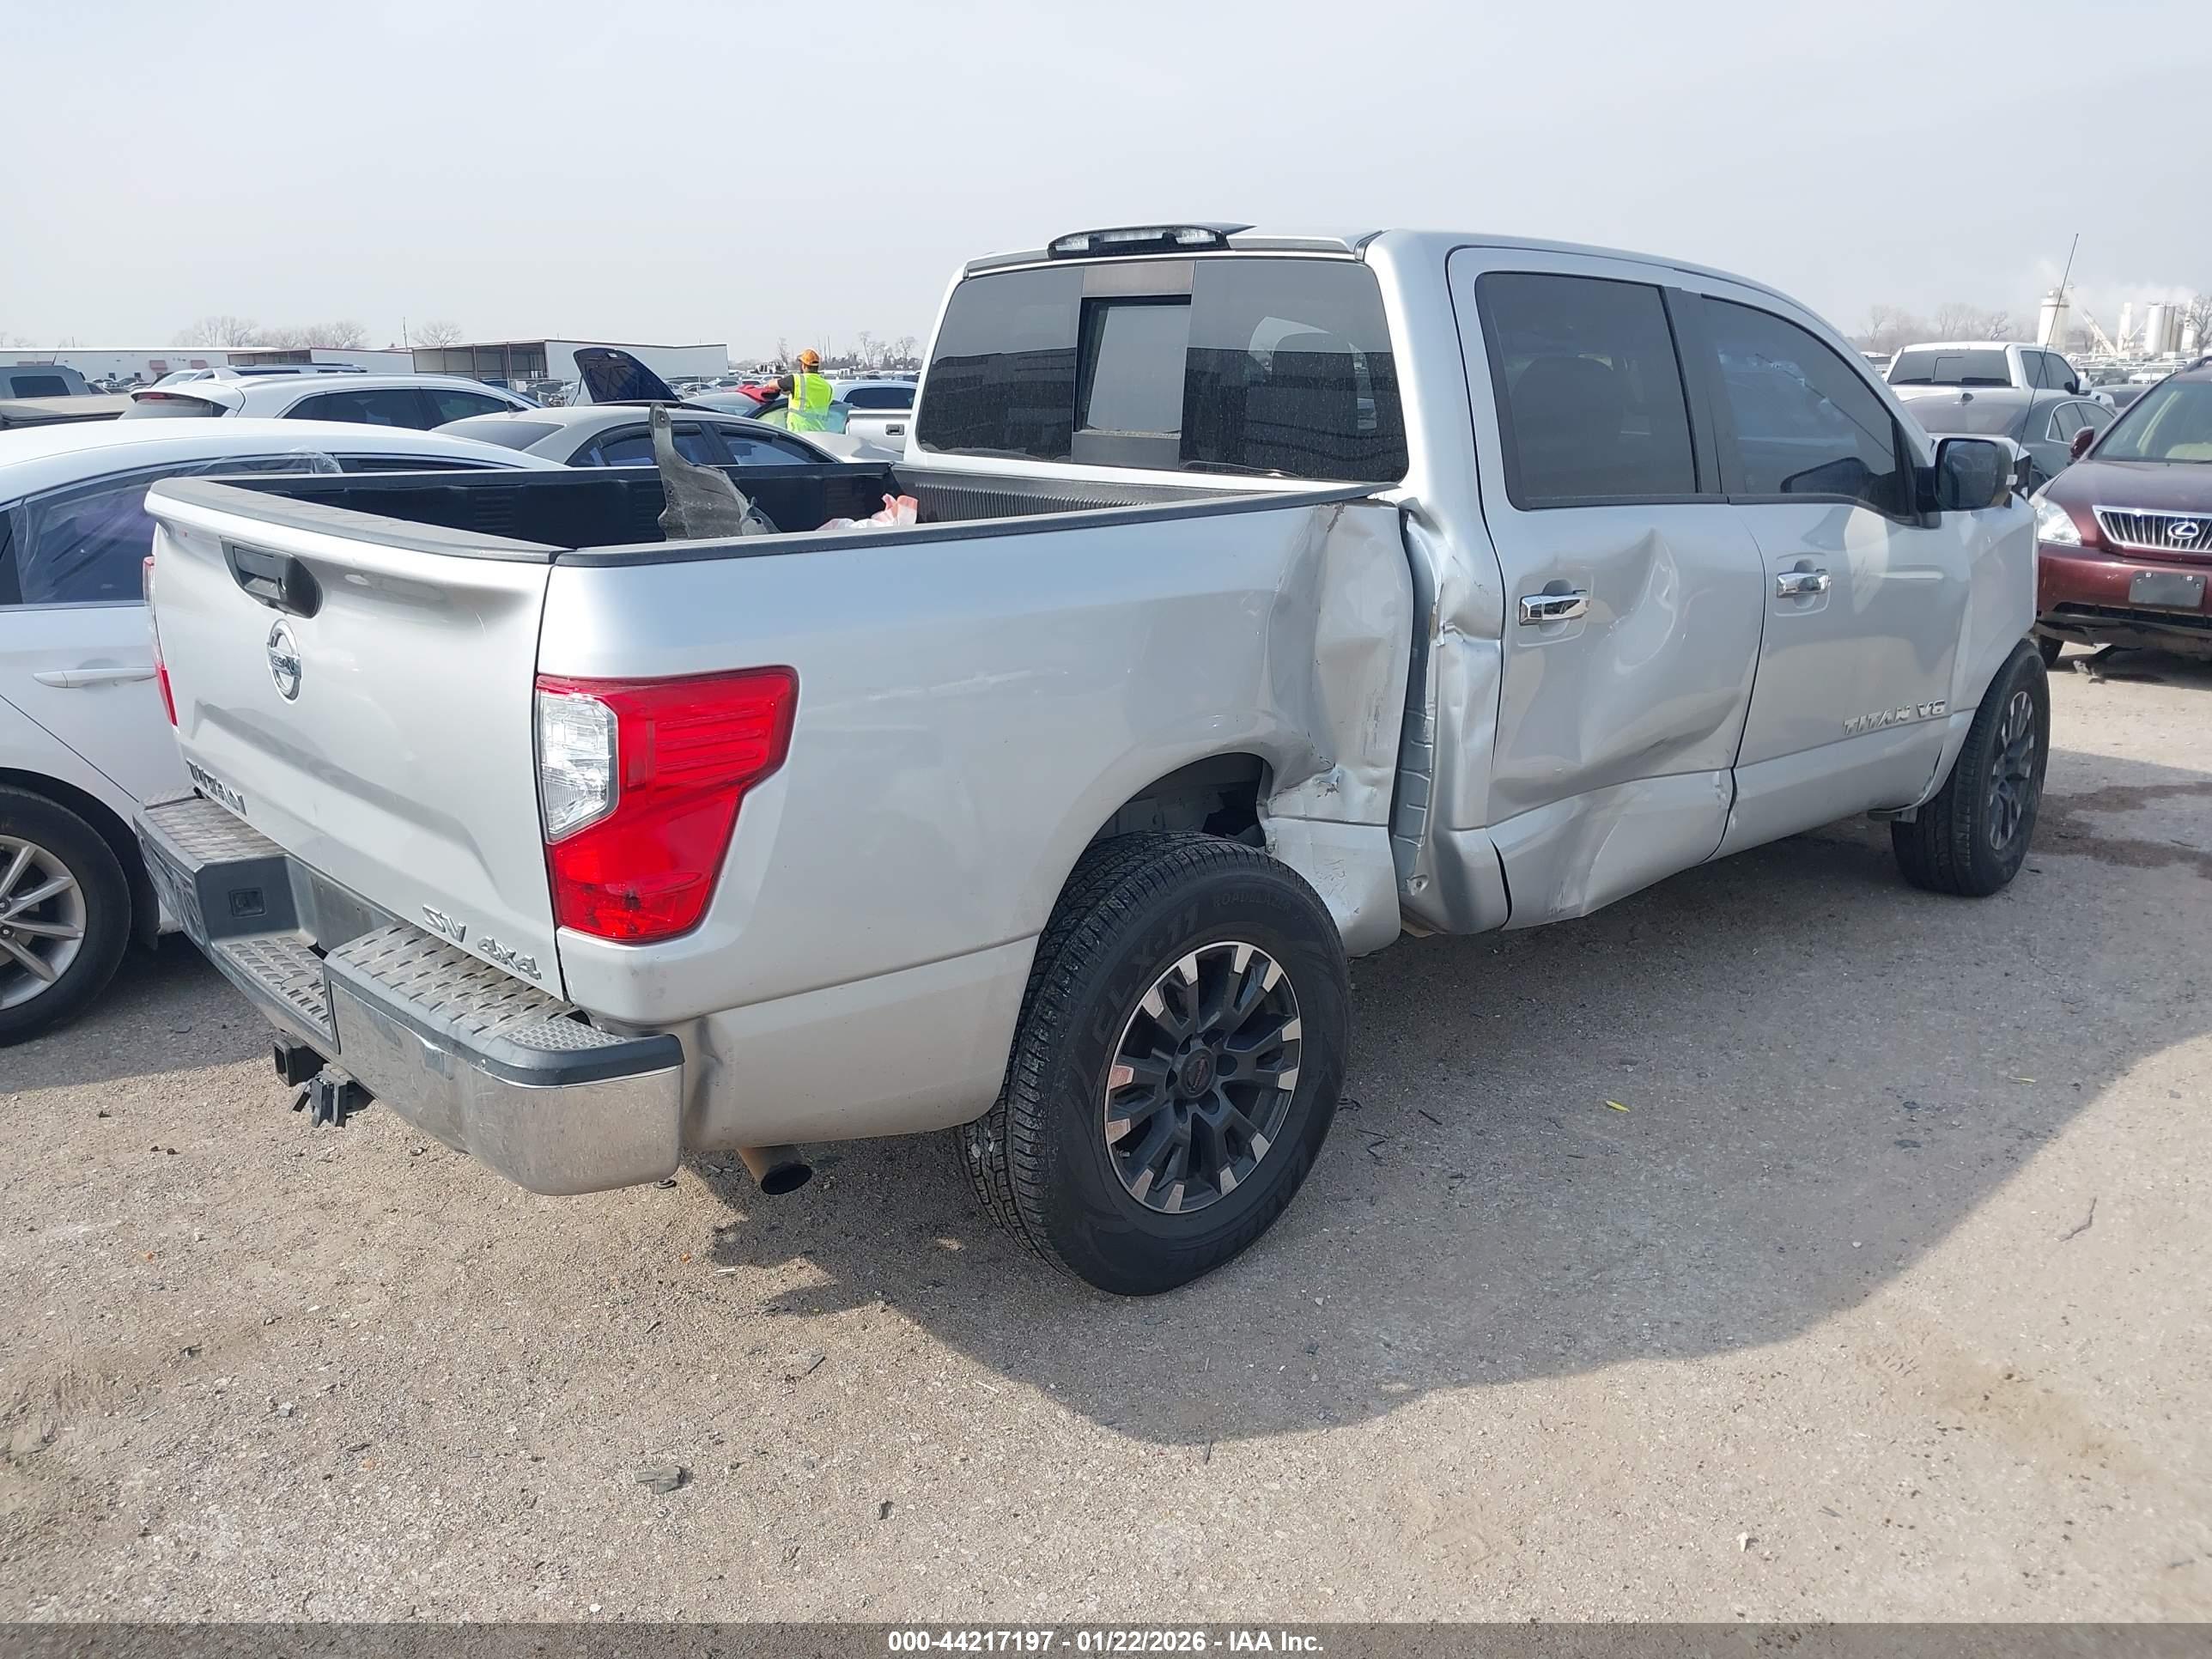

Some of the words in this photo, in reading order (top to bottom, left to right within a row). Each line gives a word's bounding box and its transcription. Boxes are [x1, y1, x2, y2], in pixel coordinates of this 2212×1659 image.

[1843, 706, 1911, 735] TITAN
[185, 758, 246, 817] TITAN
[422, 905, 466, 943] SV
